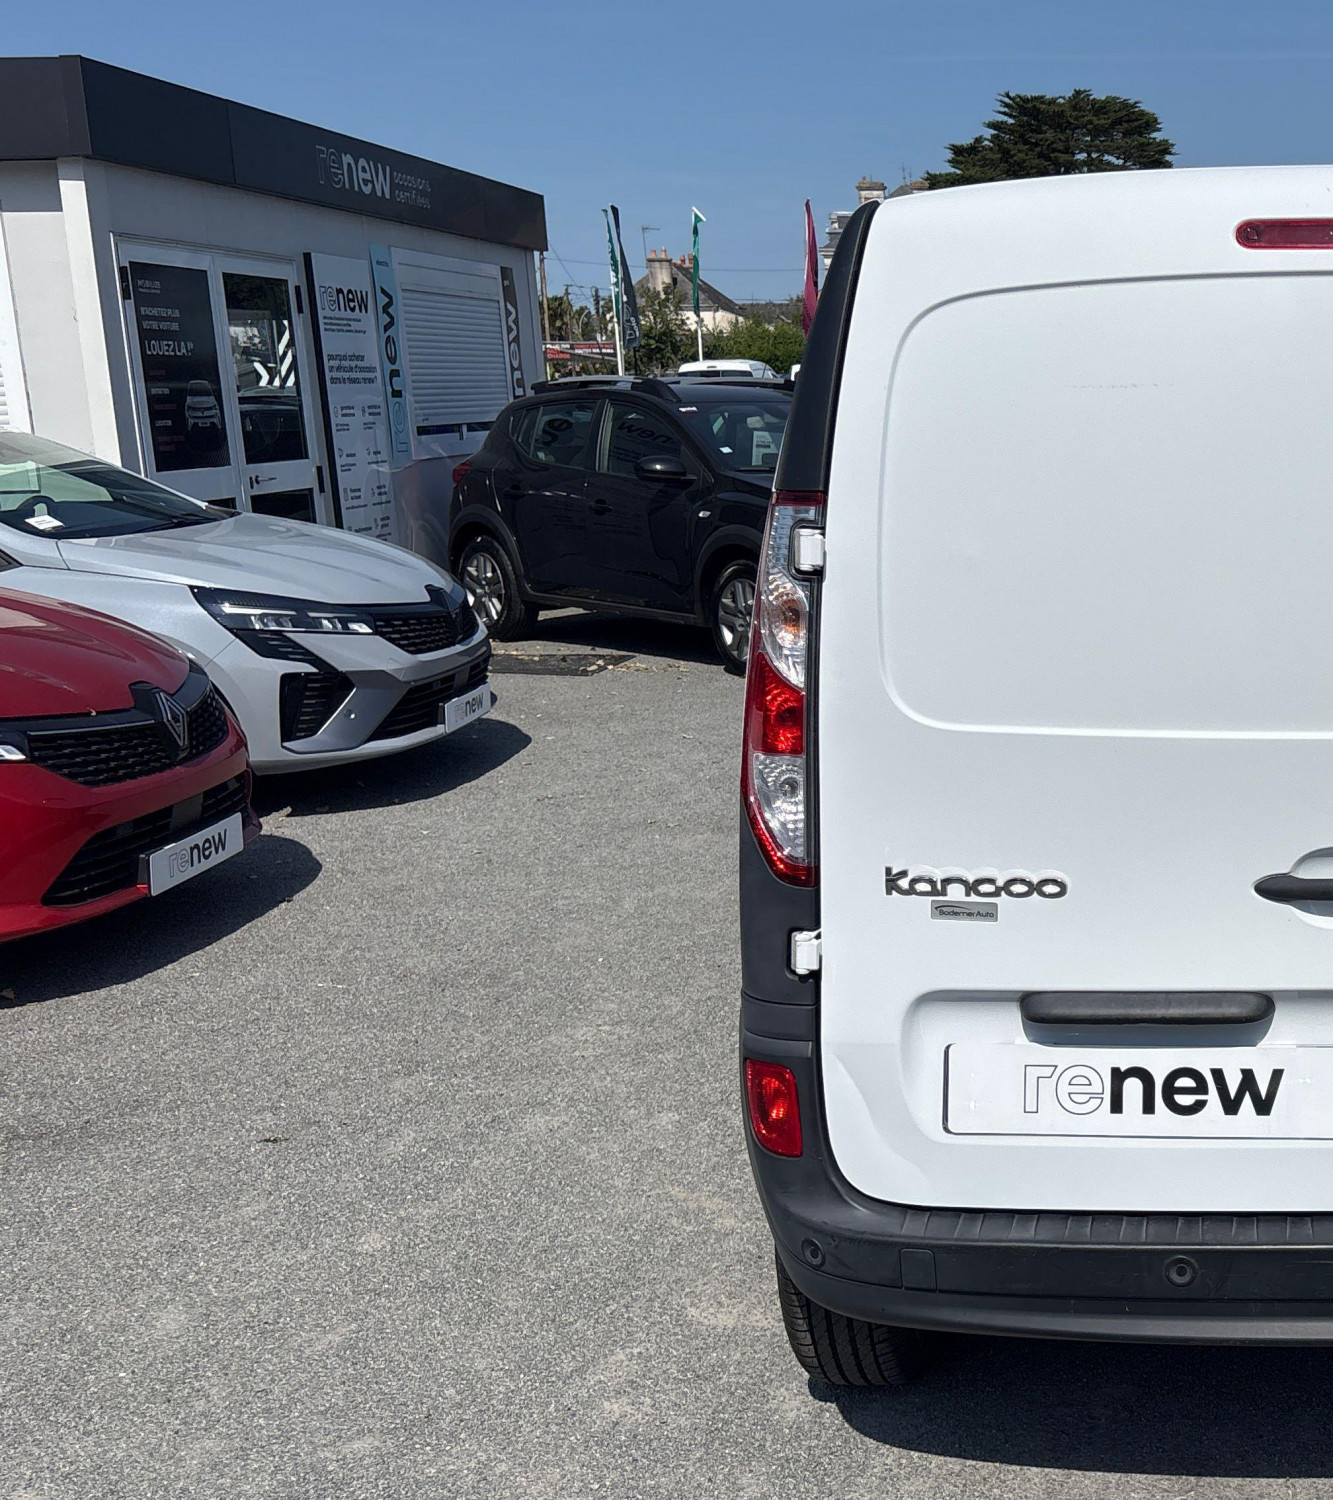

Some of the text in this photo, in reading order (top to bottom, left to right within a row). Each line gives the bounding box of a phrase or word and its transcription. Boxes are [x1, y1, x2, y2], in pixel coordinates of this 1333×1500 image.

[315, 144, 391, 200] renew
[319, 285, 369, 314] renew
[145, 340, 175, 356] LOUEZ
[175, 340, 188, 356] LA
[505, 301, 524, 397] new
[168, 827, 228, 878] renew
[1023, 1064, 1286, 1117] renew
